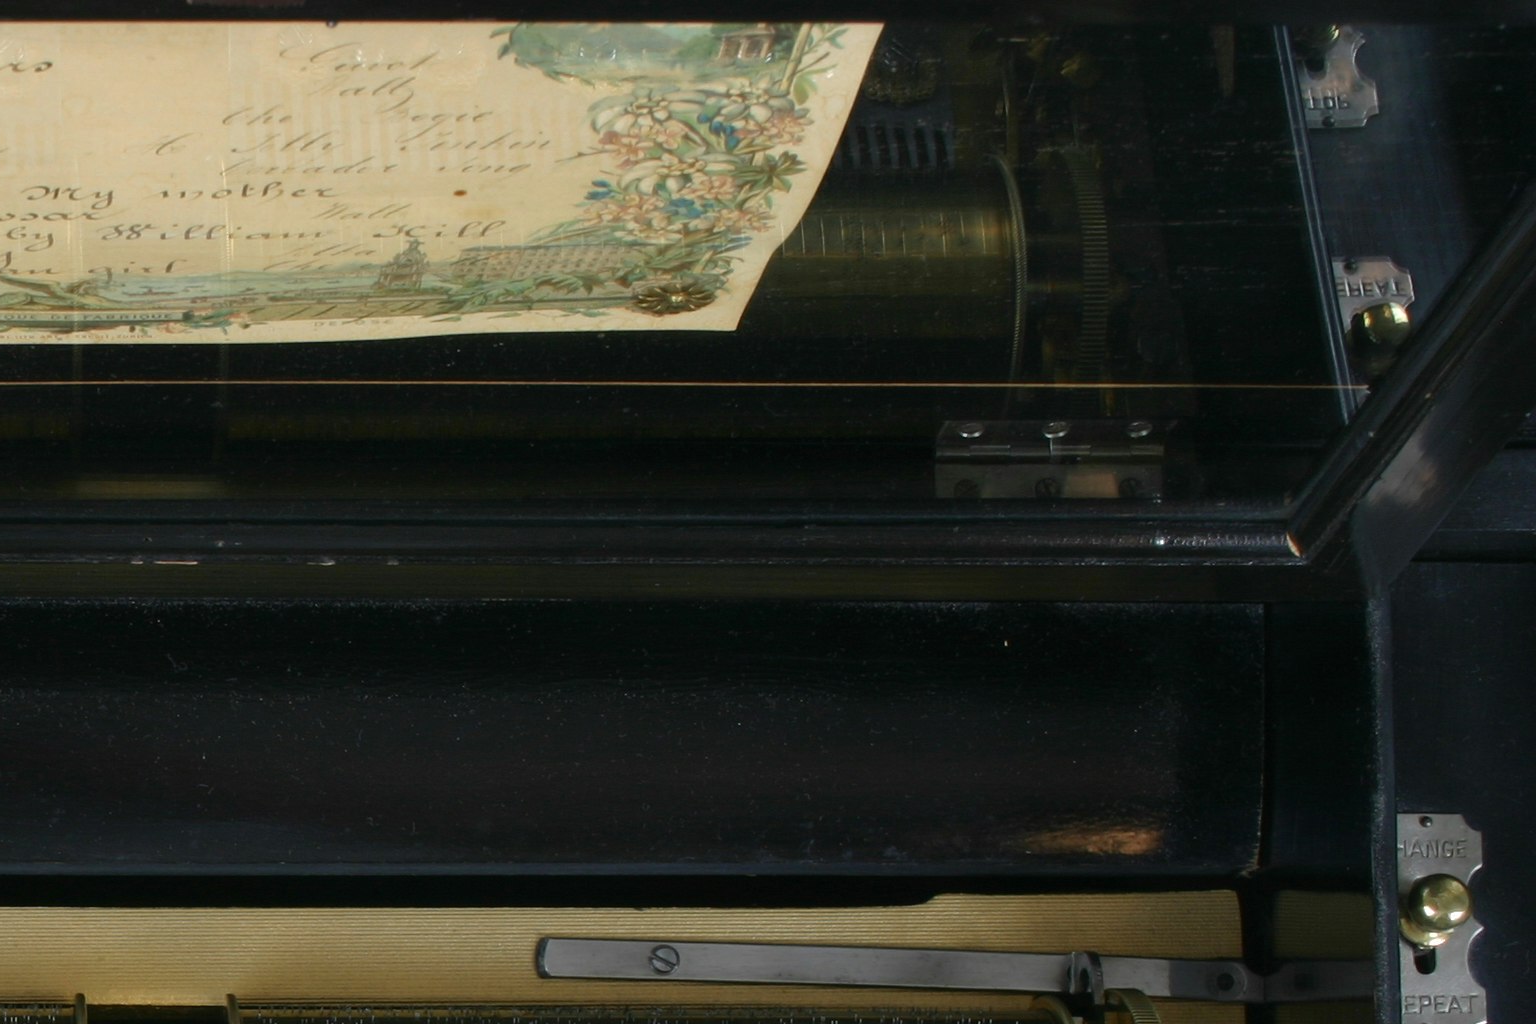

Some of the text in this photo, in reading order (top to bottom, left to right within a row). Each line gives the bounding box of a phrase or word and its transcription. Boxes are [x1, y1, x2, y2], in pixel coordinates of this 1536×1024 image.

[152, 181, 339, 203] mother
[7, 226, 55, 251] by
[97, 223, 324, 241] William
[373, 220, 507, 238] Hill
[88, 259, 189, 284] girl
[83, 312, 173, 321] FABRIQUE
[1397, 839, 1468, 859] HANGE
[1404, 994, 1479, 1014] EPEAT
